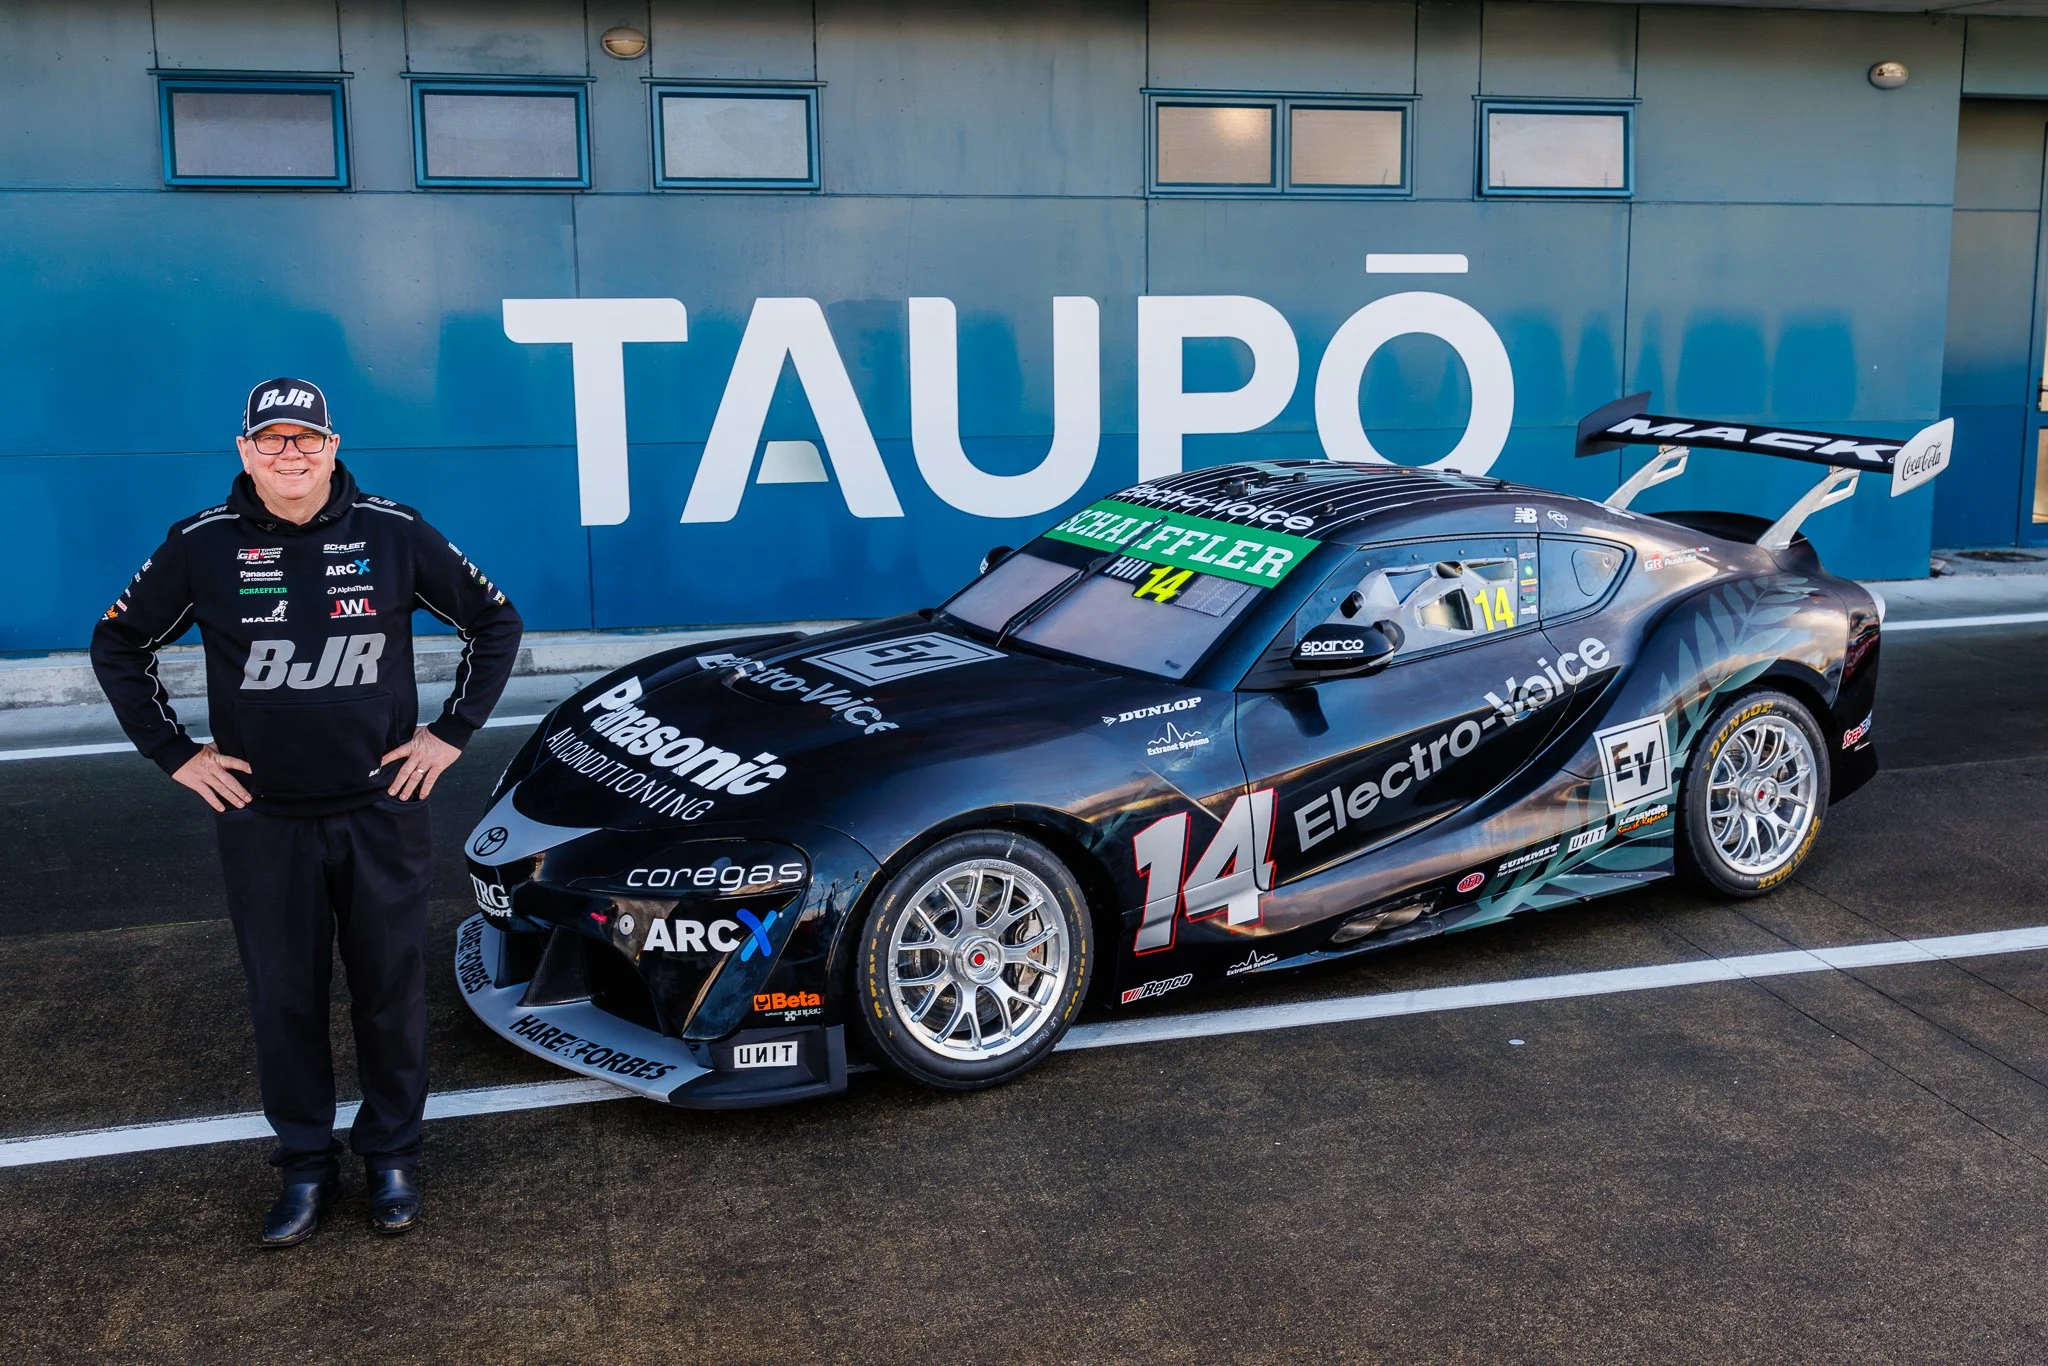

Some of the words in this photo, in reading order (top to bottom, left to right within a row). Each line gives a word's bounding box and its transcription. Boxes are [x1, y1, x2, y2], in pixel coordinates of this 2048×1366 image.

[257, 388, 315, 413] BJR
[503, 254, 1515, 527] TAUPŌ
[1606, 418, 1902, 463] MACK
[1118, 485, 1315, 531] Electro-Voice
[240, 570, 284, 579] Panasonic
[325, 559, 371, 576] ARCX
[1104, 556, 1149, 580] Hill
[1133, 565, 1194, 603] 14
[239, 587, 287, 595] SCHAEFFLER
[337, 585, 374, 594] AlphaTheta
[329, 598, 377, 616] JWL
[1473, 587, 1515, 631] 14
[239, 632, 386, 691] BJR
[1301, 639, 1364, 656] sparco
[1119, 696, 1202, 723] DUNLOP
[1293, 636, 1610, 853] Electro-Voice
[1709, 701, 1774, 760] DUNLOP
[1147, 742, 1179, 756] Extranet
[1179, 737, 1210, 749] Systems
[1610, 740, 1656, 787] EV
[1499, 843, 1560, 872] SUMMIT
[626, 862, 803, 892] coregas
[1132, 788, 1279, 957] 14
[469, 872, 510, 909] TRG
[643, 908, 778, 963] ARCX
[1226, 963, 1252, 976] Extranet
[1253, 956, 1279, 969] Systems
[1141, 973, 1193, 998] Repco
[771, 991, 821, 1010] Beta
